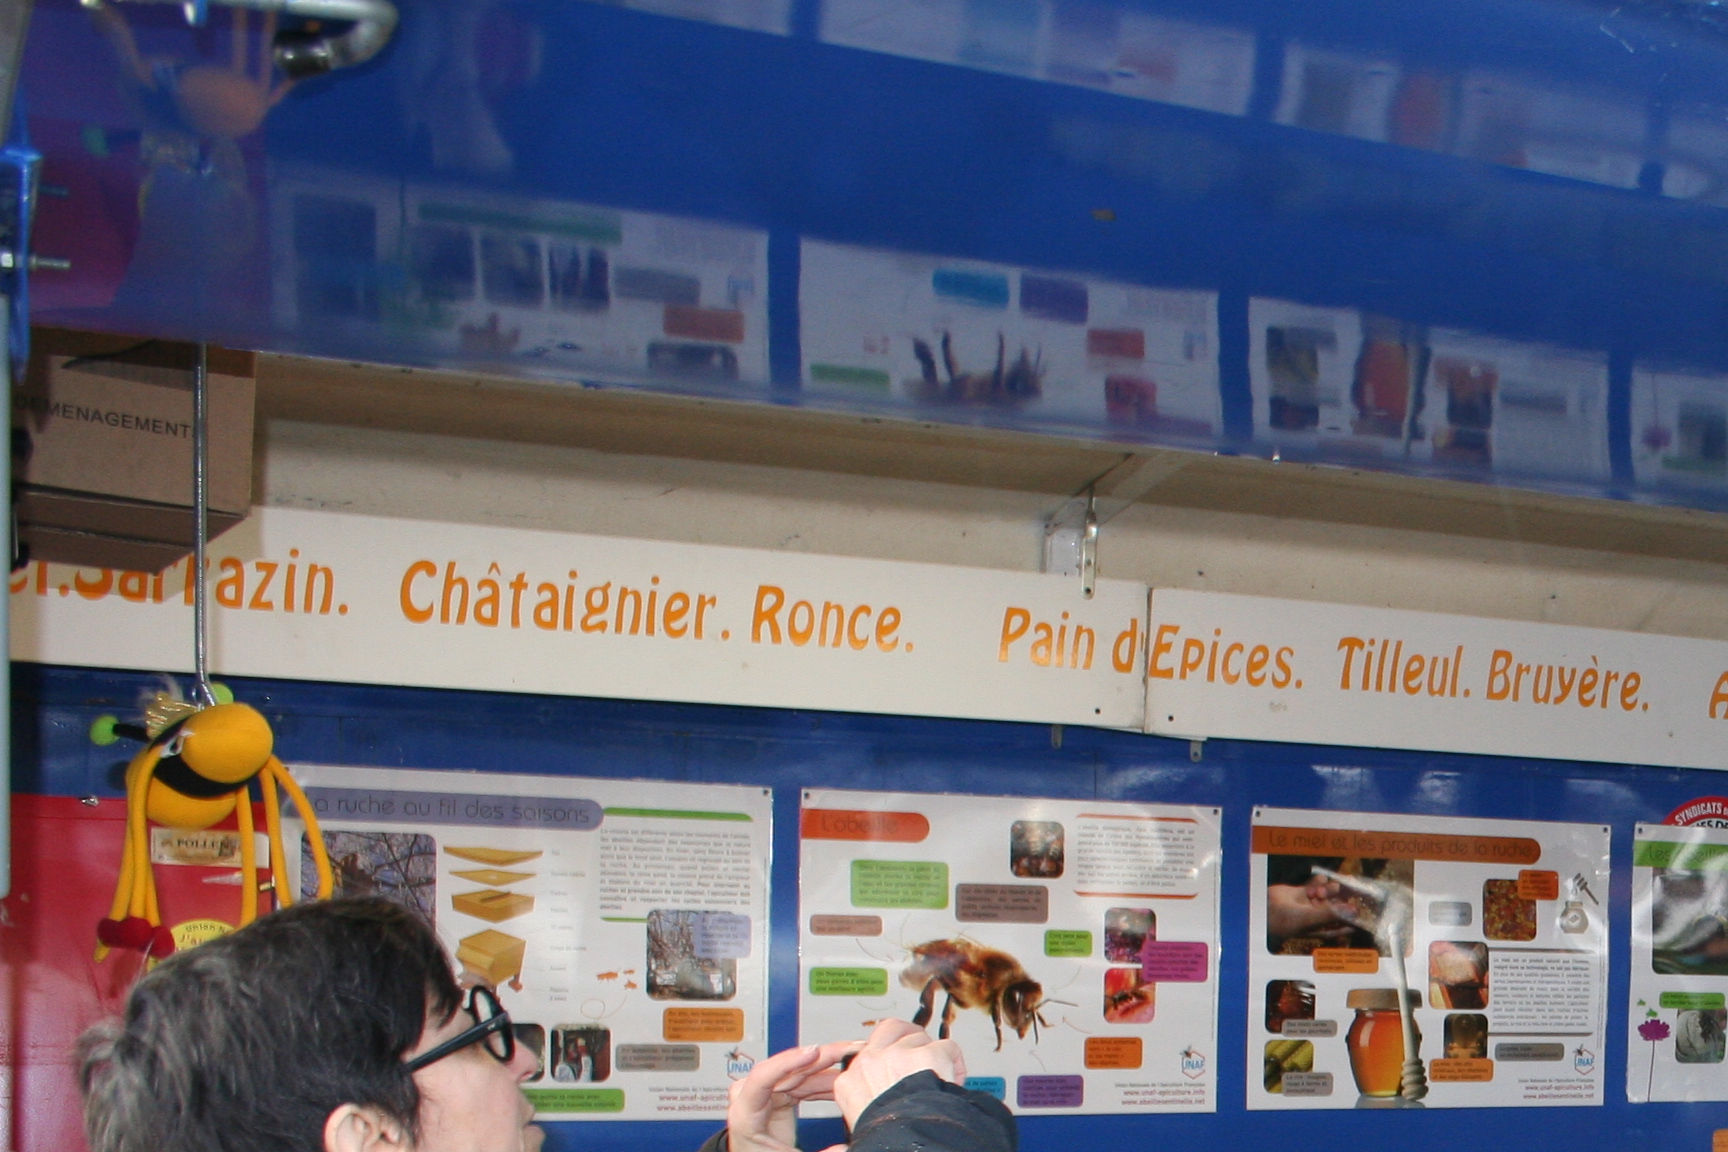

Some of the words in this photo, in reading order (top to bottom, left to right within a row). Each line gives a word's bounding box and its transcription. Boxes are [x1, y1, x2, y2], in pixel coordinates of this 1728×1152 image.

[399, 559, 731, 642] Châtaignier.
[751, 584, 915, 654] Ronce.
[998, 606, 1097, 673] Pain
[1337, 636, 1471, 699] Tilleul.
[1486, 649, 1649, 713] Bruyère.
[336, 794, 395, 815] ruche
[403, 801, 430, 817] au
[465, 800, 504, 820] des
[511, 804, 590, 824] saisons
[1675, 801, 1723, 826] SYNDICATS
[1268, 830, 1286, 847] Le
[1293, 833, 1326, 848] miel
[1331, 835, 1347, 849] et
[1353, 835, 1376, 850] les
[1381, 837, 1443, 856] produits
[1450, 839, 1469, 854] de
[1492, 841, 1534, 858] ruche
